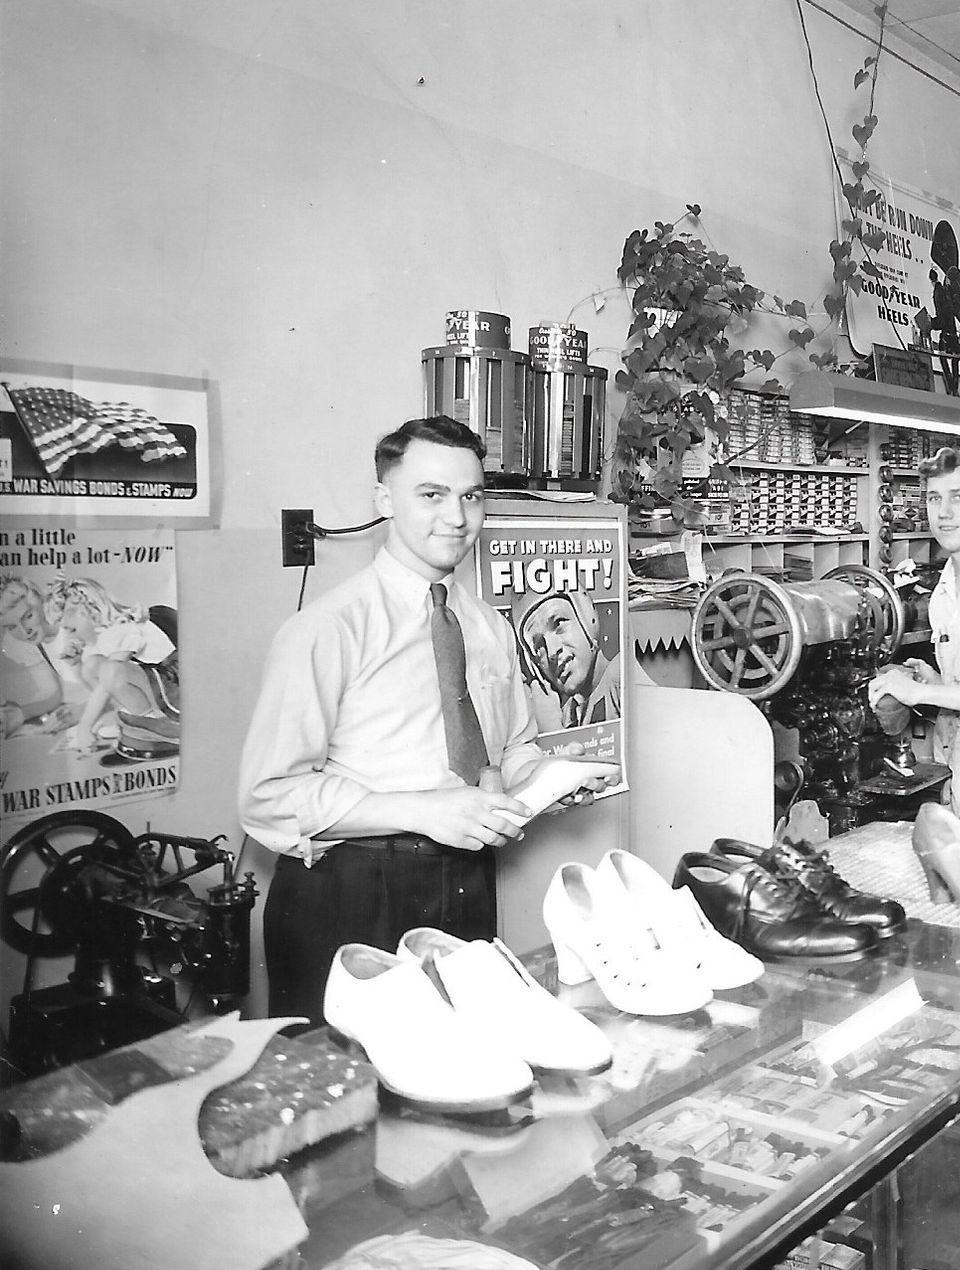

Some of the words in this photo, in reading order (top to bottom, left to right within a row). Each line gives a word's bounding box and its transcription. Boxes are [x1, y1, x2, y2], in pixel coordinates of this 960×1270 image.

[861, 278, 921, 310] GOODYEAR
[877, 304, 910, 327] HEELS
[13, 478, 38, 493] WAR
[40, 479, 87, 495] SAVINGS
[89, 481, 124, 497] BONDS
[132, 482, 172, 497] STAMPS
[172, 487, 194, 498] NOW
[15, 533, 26, 546] a
[31, 528, 76, 546] little
[489, 540, 517, 556] GET
[520, 540, 537, 555] IN
[540, 540, 583, 555] THERE
[586, 539, 613, 554] AND
[28, 548, 67, 569] help
[72, 552, 82, 565] a
[87, 547, 111, 564] lot
[490, 558, 614, 596] FIGHT!
[2, 788, 41, 813] WAR
[46, 775, 110, 806] STAMPS
[124, 765, 177, 792] BONDS
